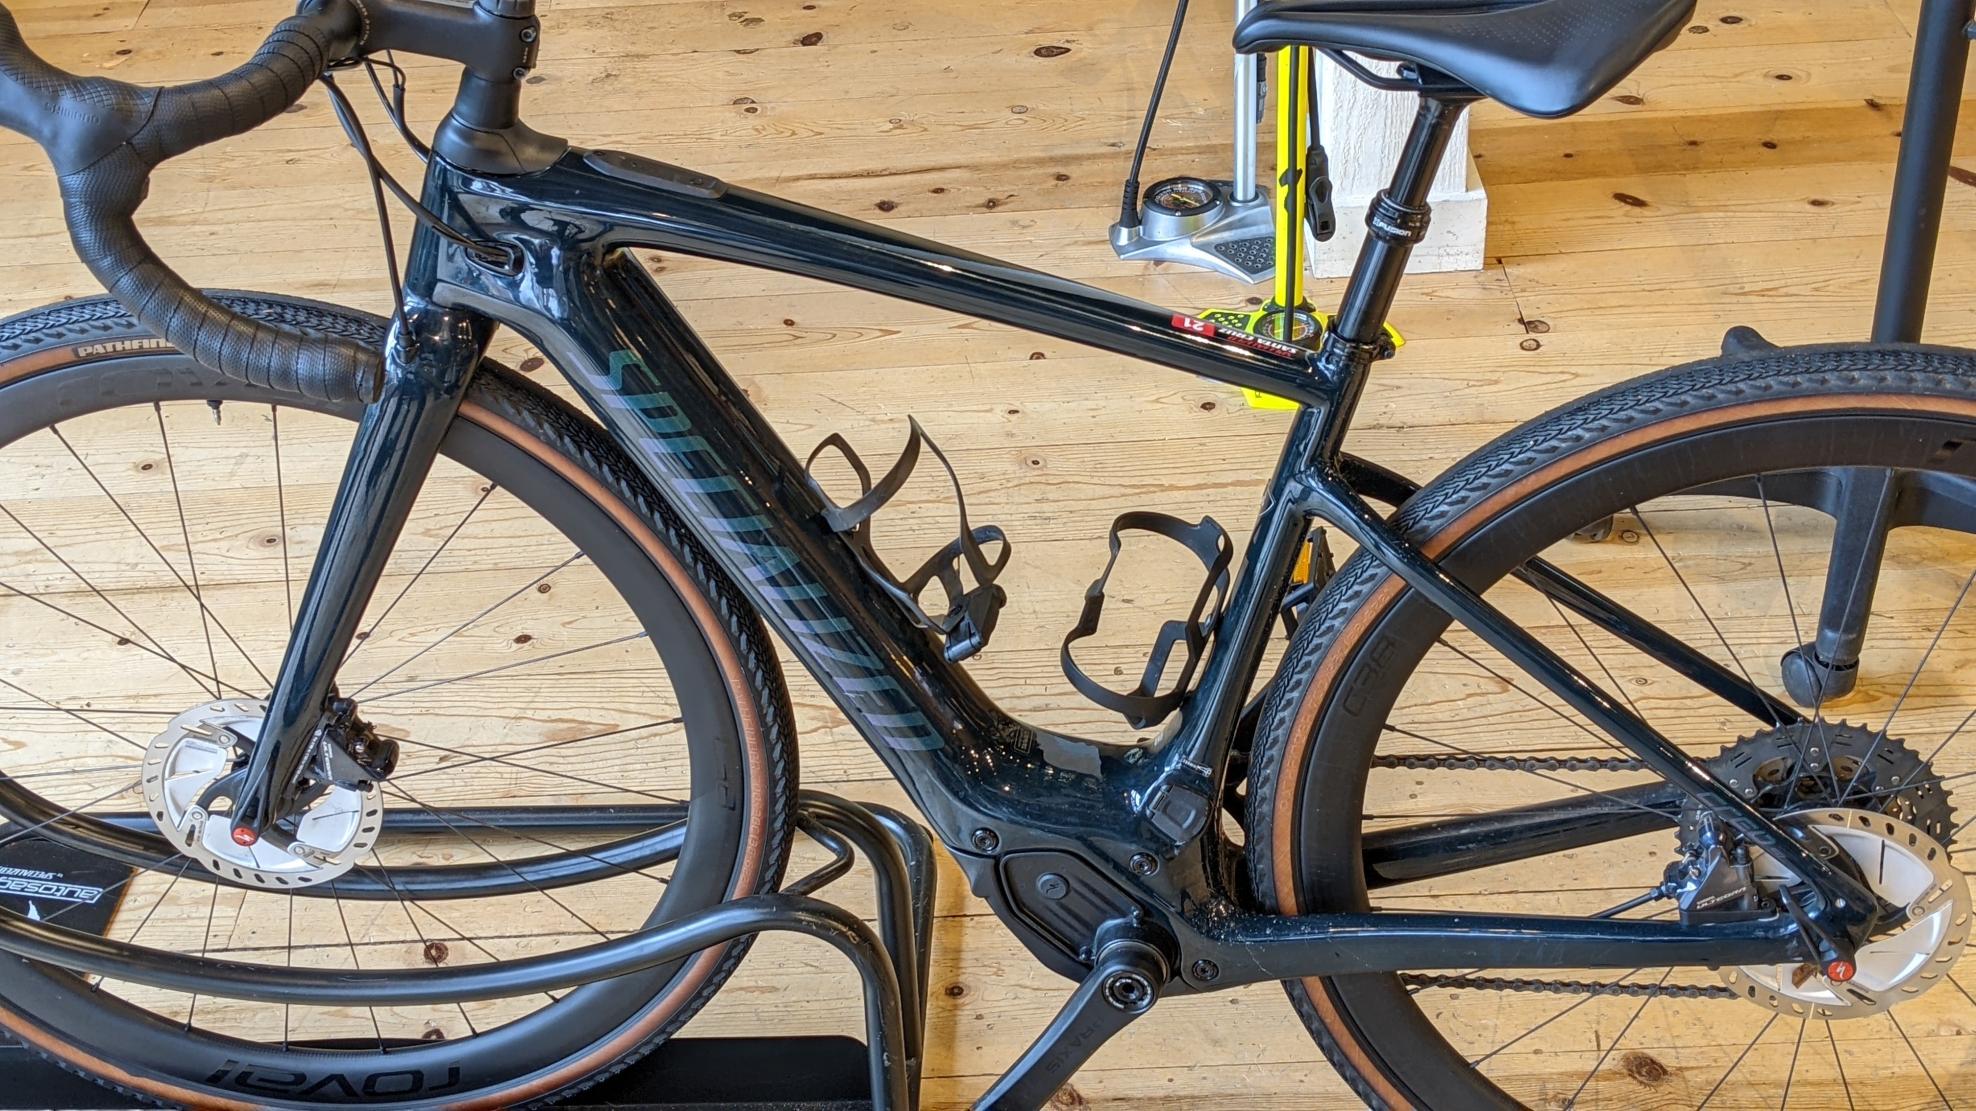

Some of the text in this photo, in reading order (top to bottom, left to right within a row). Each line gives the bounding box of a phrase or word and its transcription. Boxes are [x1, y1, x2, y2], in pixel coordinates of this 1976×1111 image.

[1183, 317, 1205, 332] 21
[1218, 326, 1297, 353] SANTA CRUZ
[567, 349, 946, 751] SPECIALIZED
[204, 1059, 461, 1098] roval
